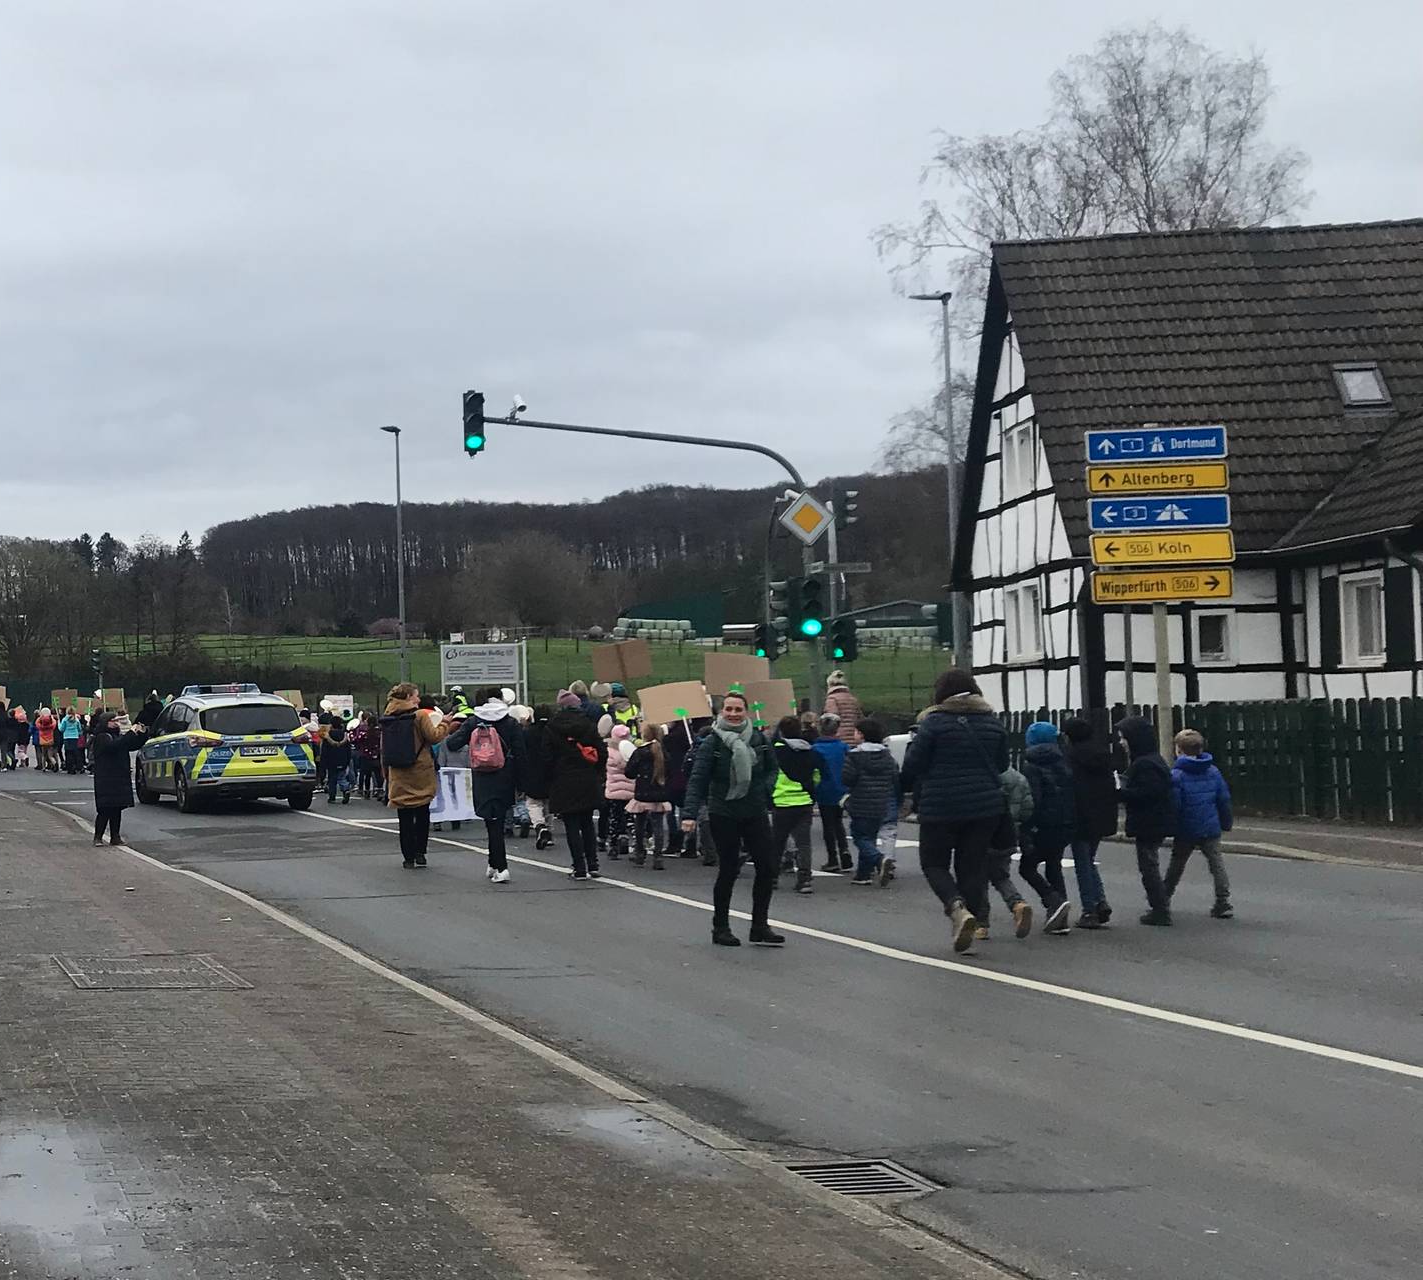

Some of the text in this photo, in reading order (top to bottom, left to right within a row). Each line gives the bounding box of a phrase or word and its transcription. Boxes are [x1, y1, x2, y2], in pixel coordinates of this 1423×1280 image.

[1170, 437, 1217, 450] Dortmund
[1122, 472, 1195, 487] Altenberg
[1129, 543, 1150, 554] 506
[1175, 579, 1196, 590] 506
